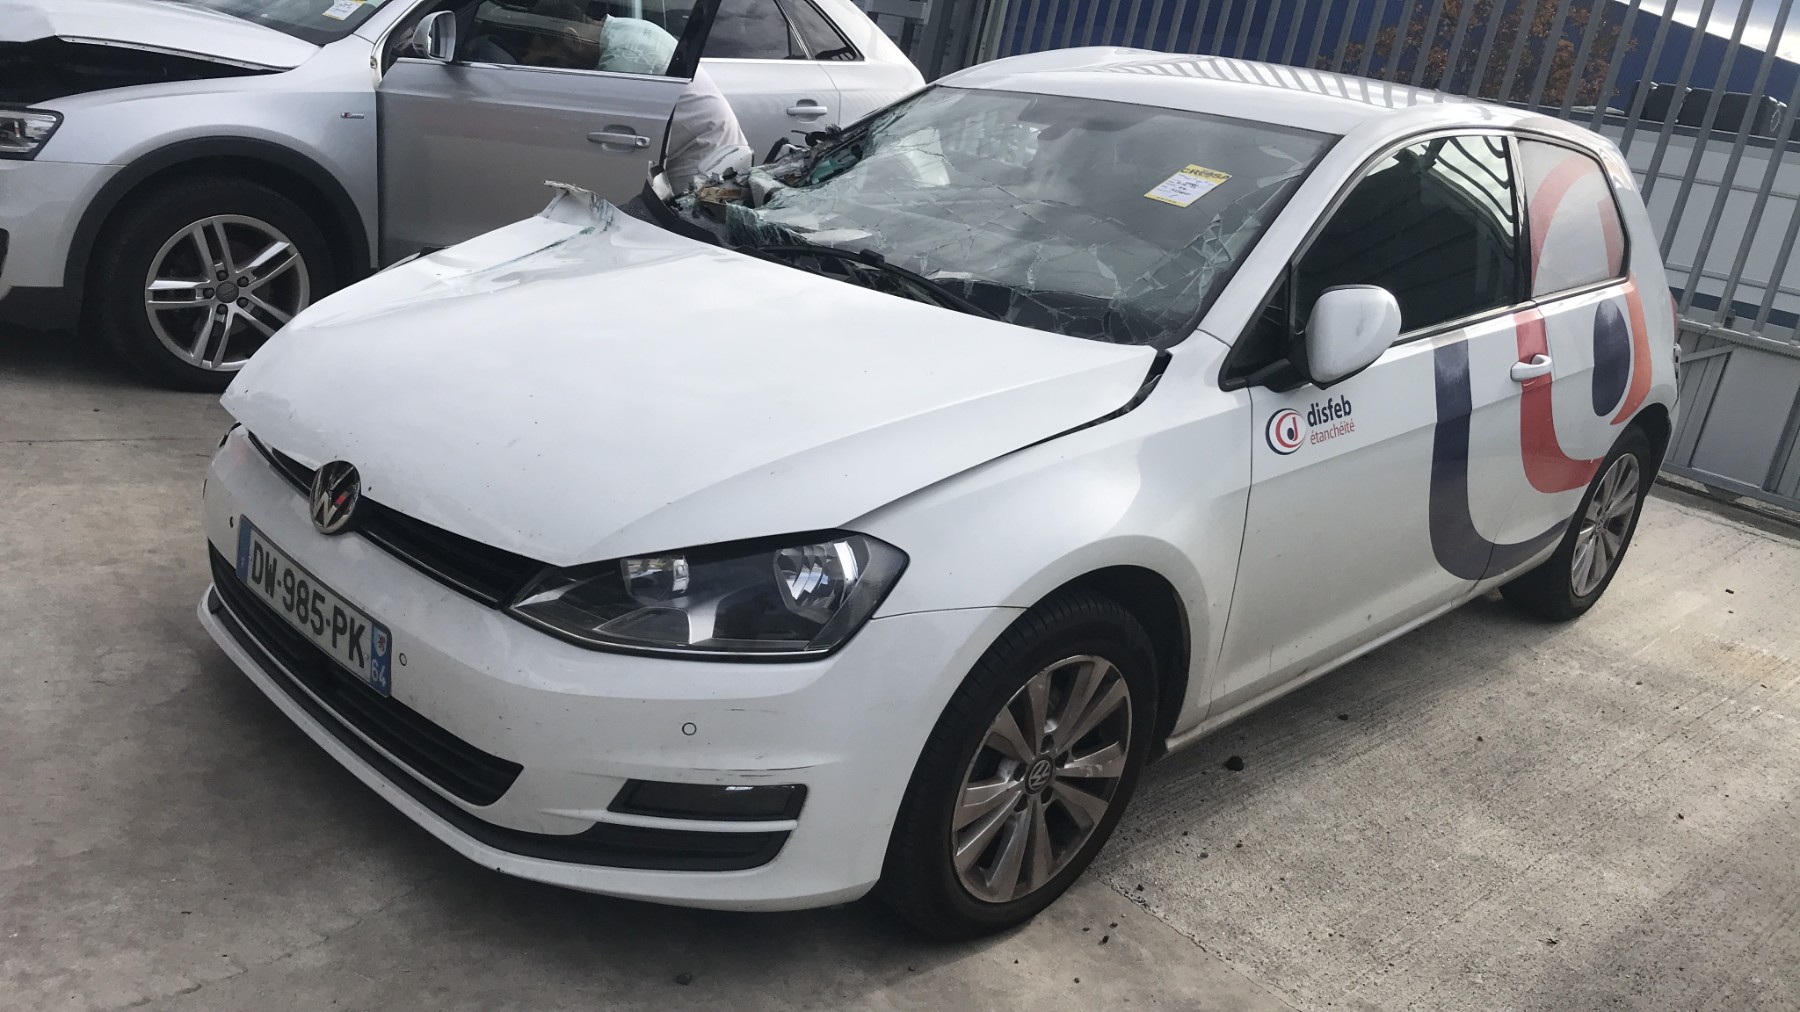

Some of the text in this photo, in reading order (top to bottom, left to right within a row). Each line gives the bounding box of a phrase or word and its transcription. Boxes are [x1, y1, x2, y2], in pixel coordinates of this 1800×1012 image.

[1307, 394, 1352, 428] disfeb
[1309, 418, 1355, 445] étanchéité
[251, 540, 366, 669] DW-985-PK
[371, 658, 387, 688] 64
